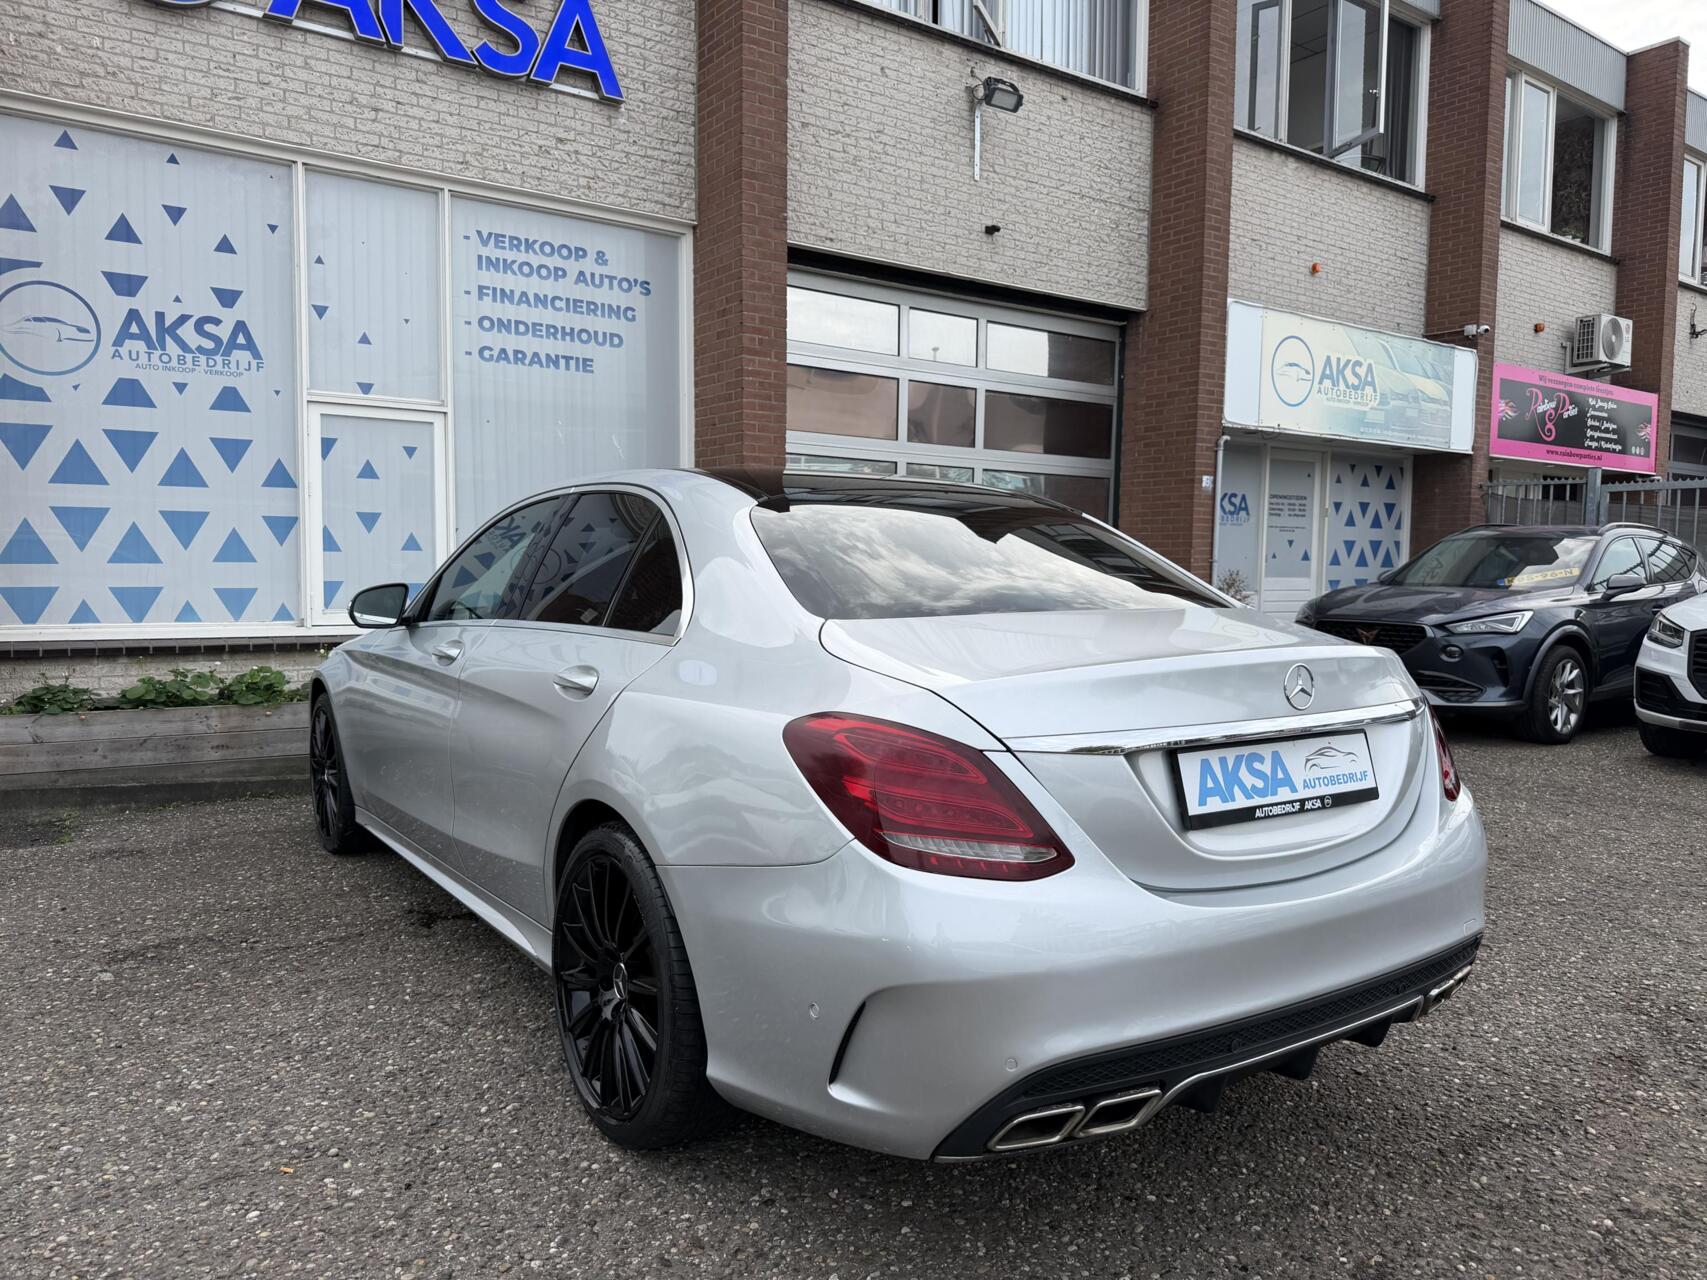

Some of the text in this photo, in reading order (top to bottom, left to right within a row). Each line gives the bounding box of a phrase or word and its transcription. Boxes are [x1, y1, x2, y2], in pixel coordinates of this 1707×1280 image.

[475, 229, 588, 262] VERKOOP
[594, 250, 609, 267] &
[477, 254, 652, 297] INKOOP AUTO'S
[477, 284, 637, 322] FINANCIERING
[111, 308, 263, 361] AKSA
[477, 315, 624, 349] ONDERHOUD
[111, 348, 265, 372] AUTOBEDRIJF
[135, 363, 159, 371] AUTO
[162, 365, 197, 374] INKOOP
[203, 368, 244, 378] VERKOOP
[478, 345, 594, 374] GARANTIE
[1318, 355, 1377, 393] AKSA
[1317, 385, 1379, 403] AUTOBEDRIJF
[1220, 492, 1250, 516] KSA
[1198, 750, 1298, 807] AKSA
[1302, 770, 1369, 791] AUTOBEDRIJF
[1255, 798, 1322, 818] AUTOBEDRIJF AKSA
